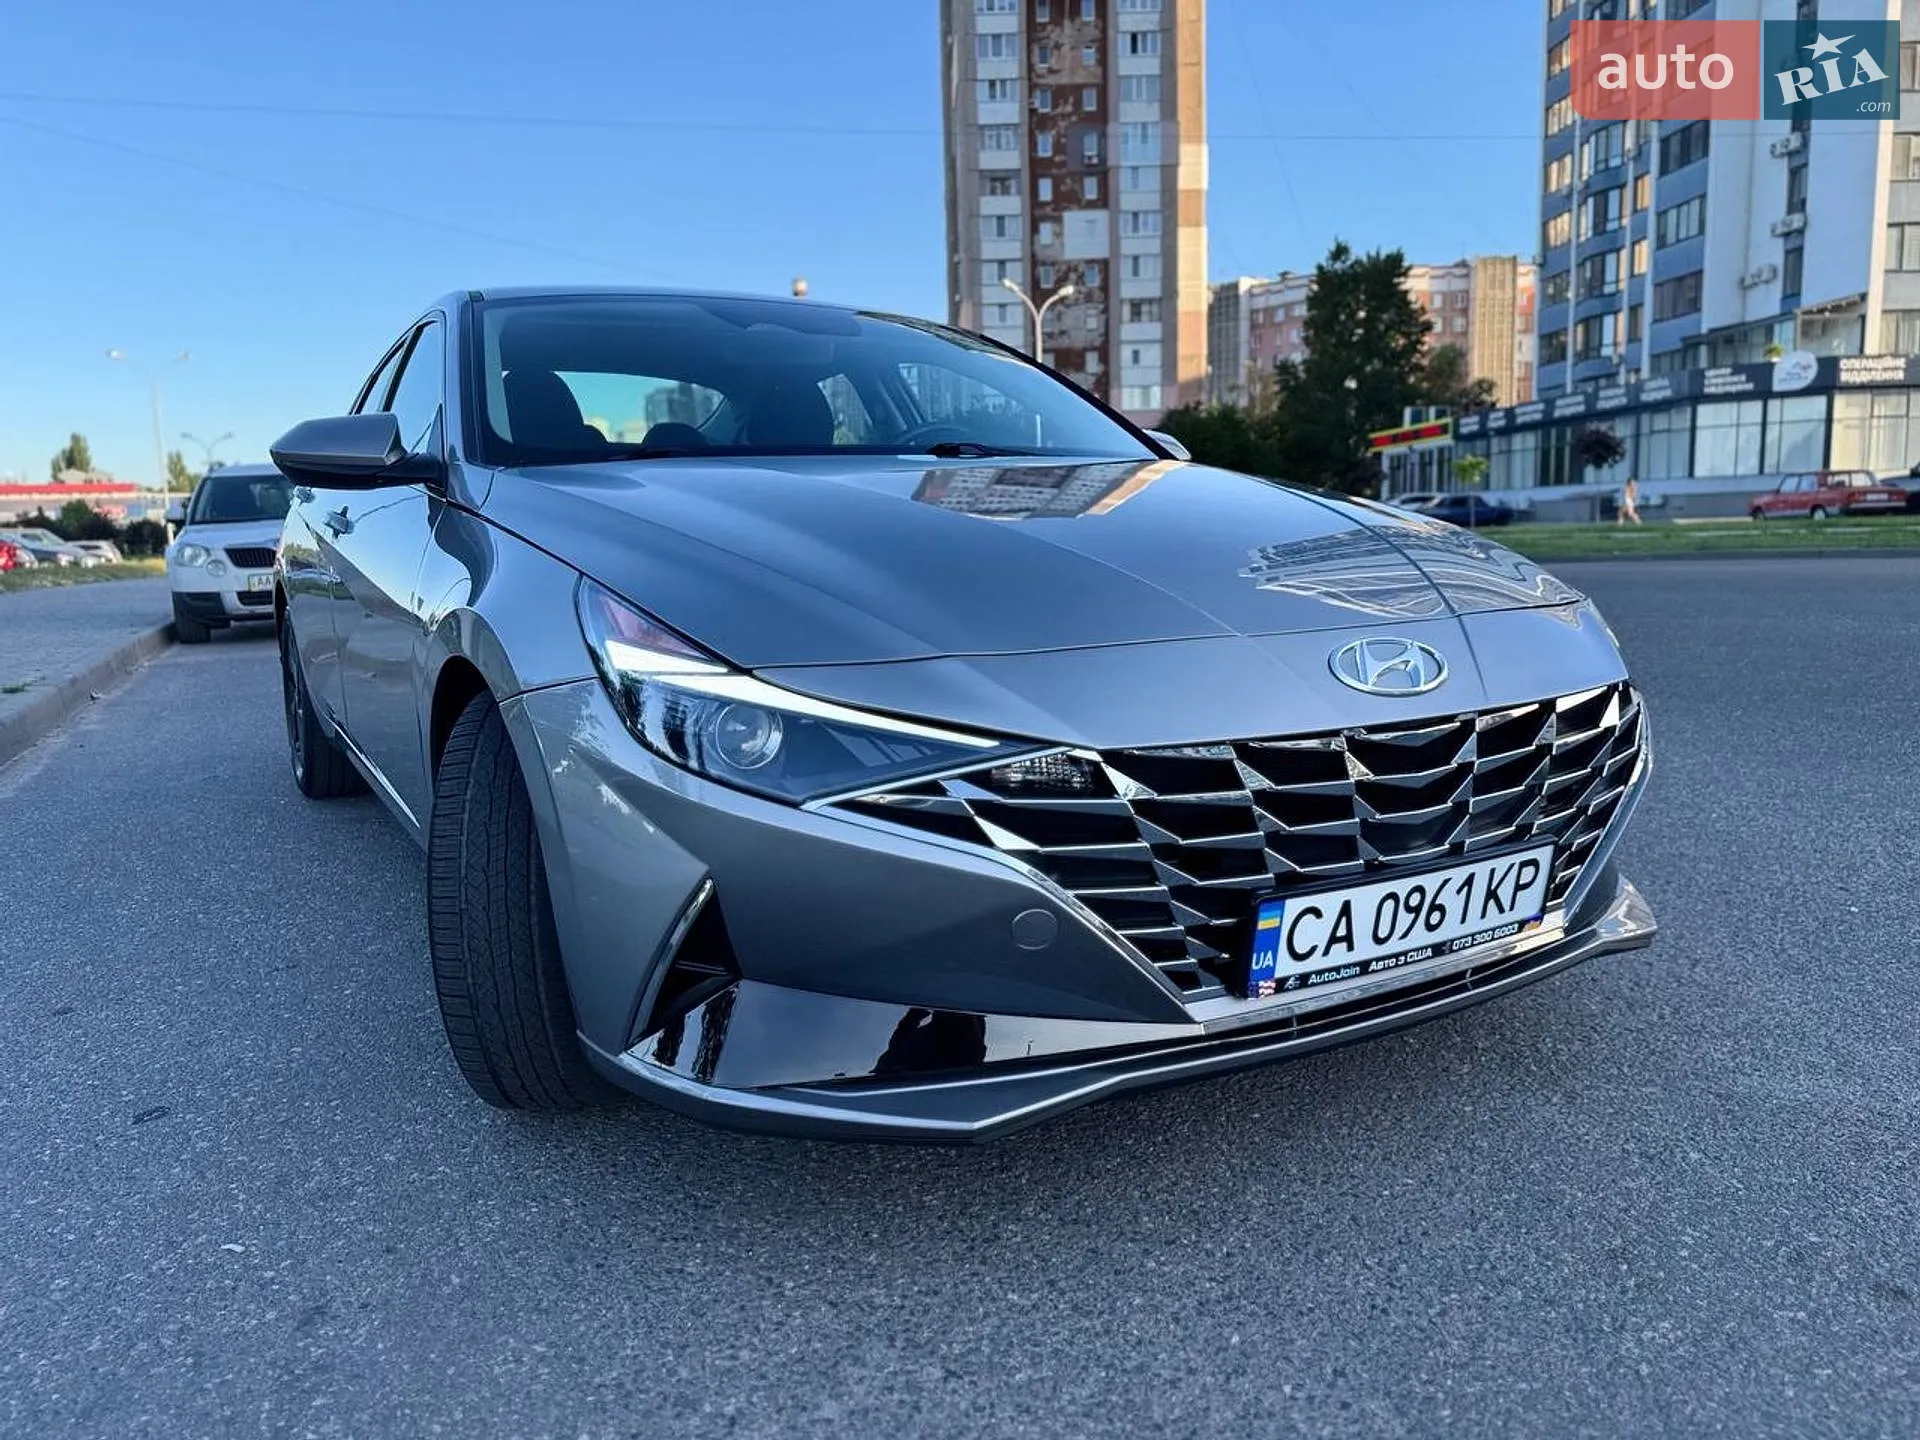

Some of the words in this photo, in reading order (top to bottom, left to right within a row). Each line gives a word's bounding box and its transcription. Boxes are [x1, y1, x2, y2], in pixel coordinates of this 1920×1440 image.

[1285, 899, 1355, 962] CA
[1371, 871, 1477, 946] 0961
[1480, 857, 1541, 920] KP
[1452, 938, 1473, 951] 073
[1474, 933, 1492, 944] 300
[1493, 923, 1519, 940] 6003
[1251, 952, 1275, 971] UA
[1406, 948, 1433, 963] США
[1308, 966, 1361, 985] AutoJoin
